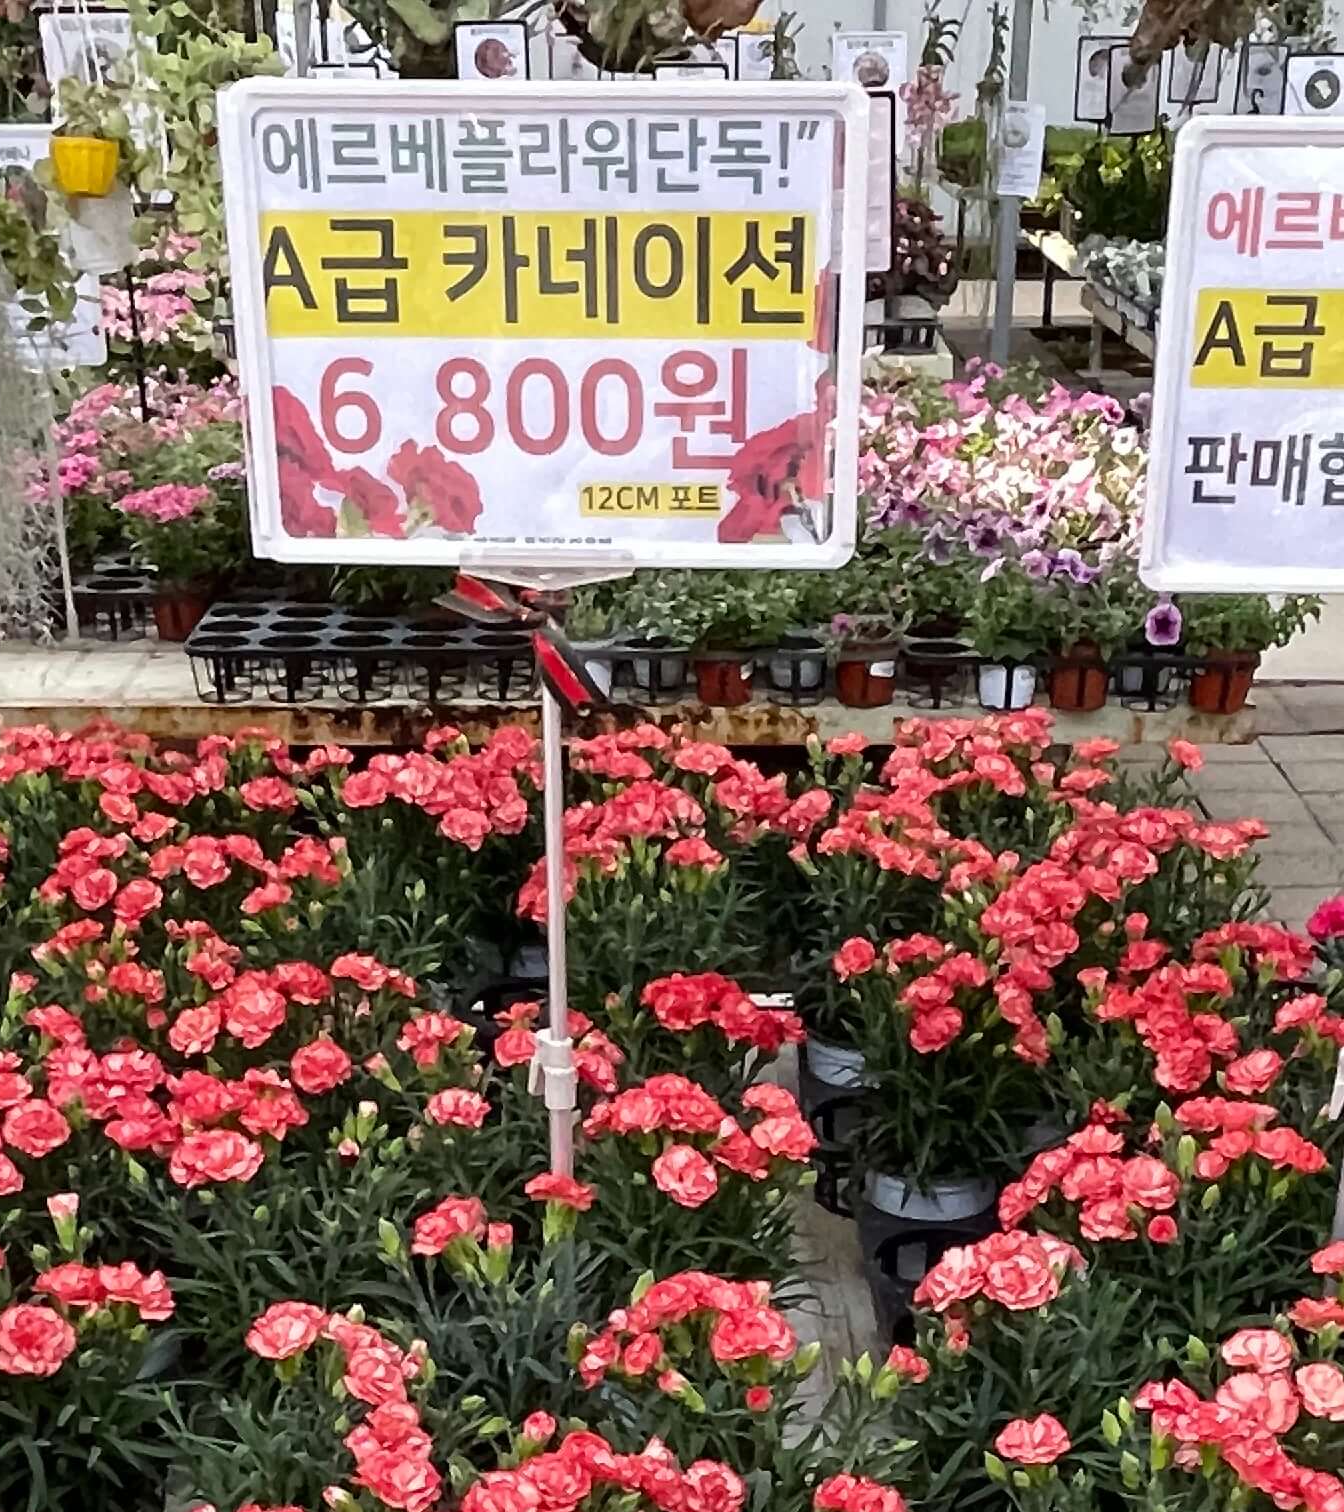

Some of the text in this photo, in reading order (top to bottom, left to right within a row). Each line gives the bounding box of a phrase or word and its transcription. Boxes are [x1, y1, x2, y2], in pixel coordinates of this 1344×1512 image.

[263, 215, 805, 325] A급 카네이션
[1193, 295, 1325, 377] A급
[582, 485, 721, 512] 12CM 포트
